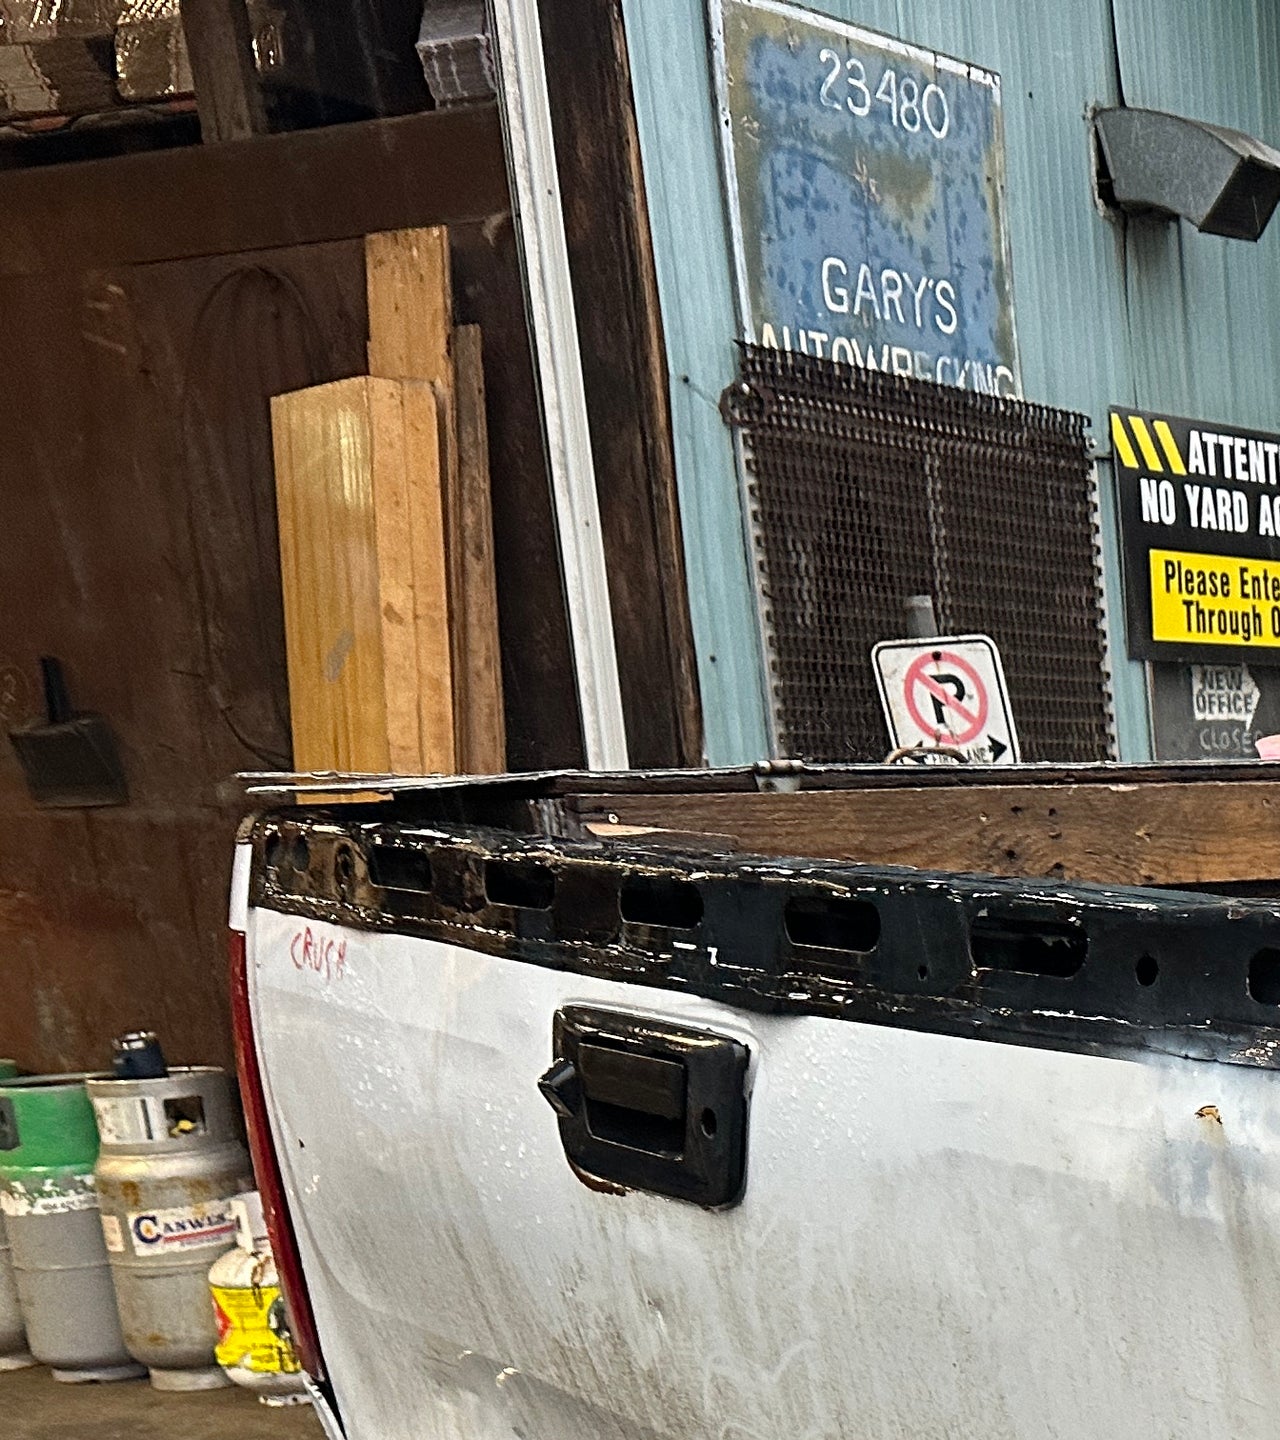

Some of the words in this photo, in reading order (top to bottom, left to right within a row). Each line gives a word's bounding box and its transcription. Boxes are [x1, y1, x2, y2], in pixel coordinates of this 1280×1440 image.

[818, 47, 950, 139] 23480
[820, 256, 959, 336] GARY'S
[1140, 477, 1176, 525] NO
[1184, 484, 1249, 534] YARD
[1163, 559, 1231, 598] Please
[1182, 599, 1263, 642] Through
[1202, 666, 1243, 691] NEW
[1195, 688, 1254, 715] OFFICE
